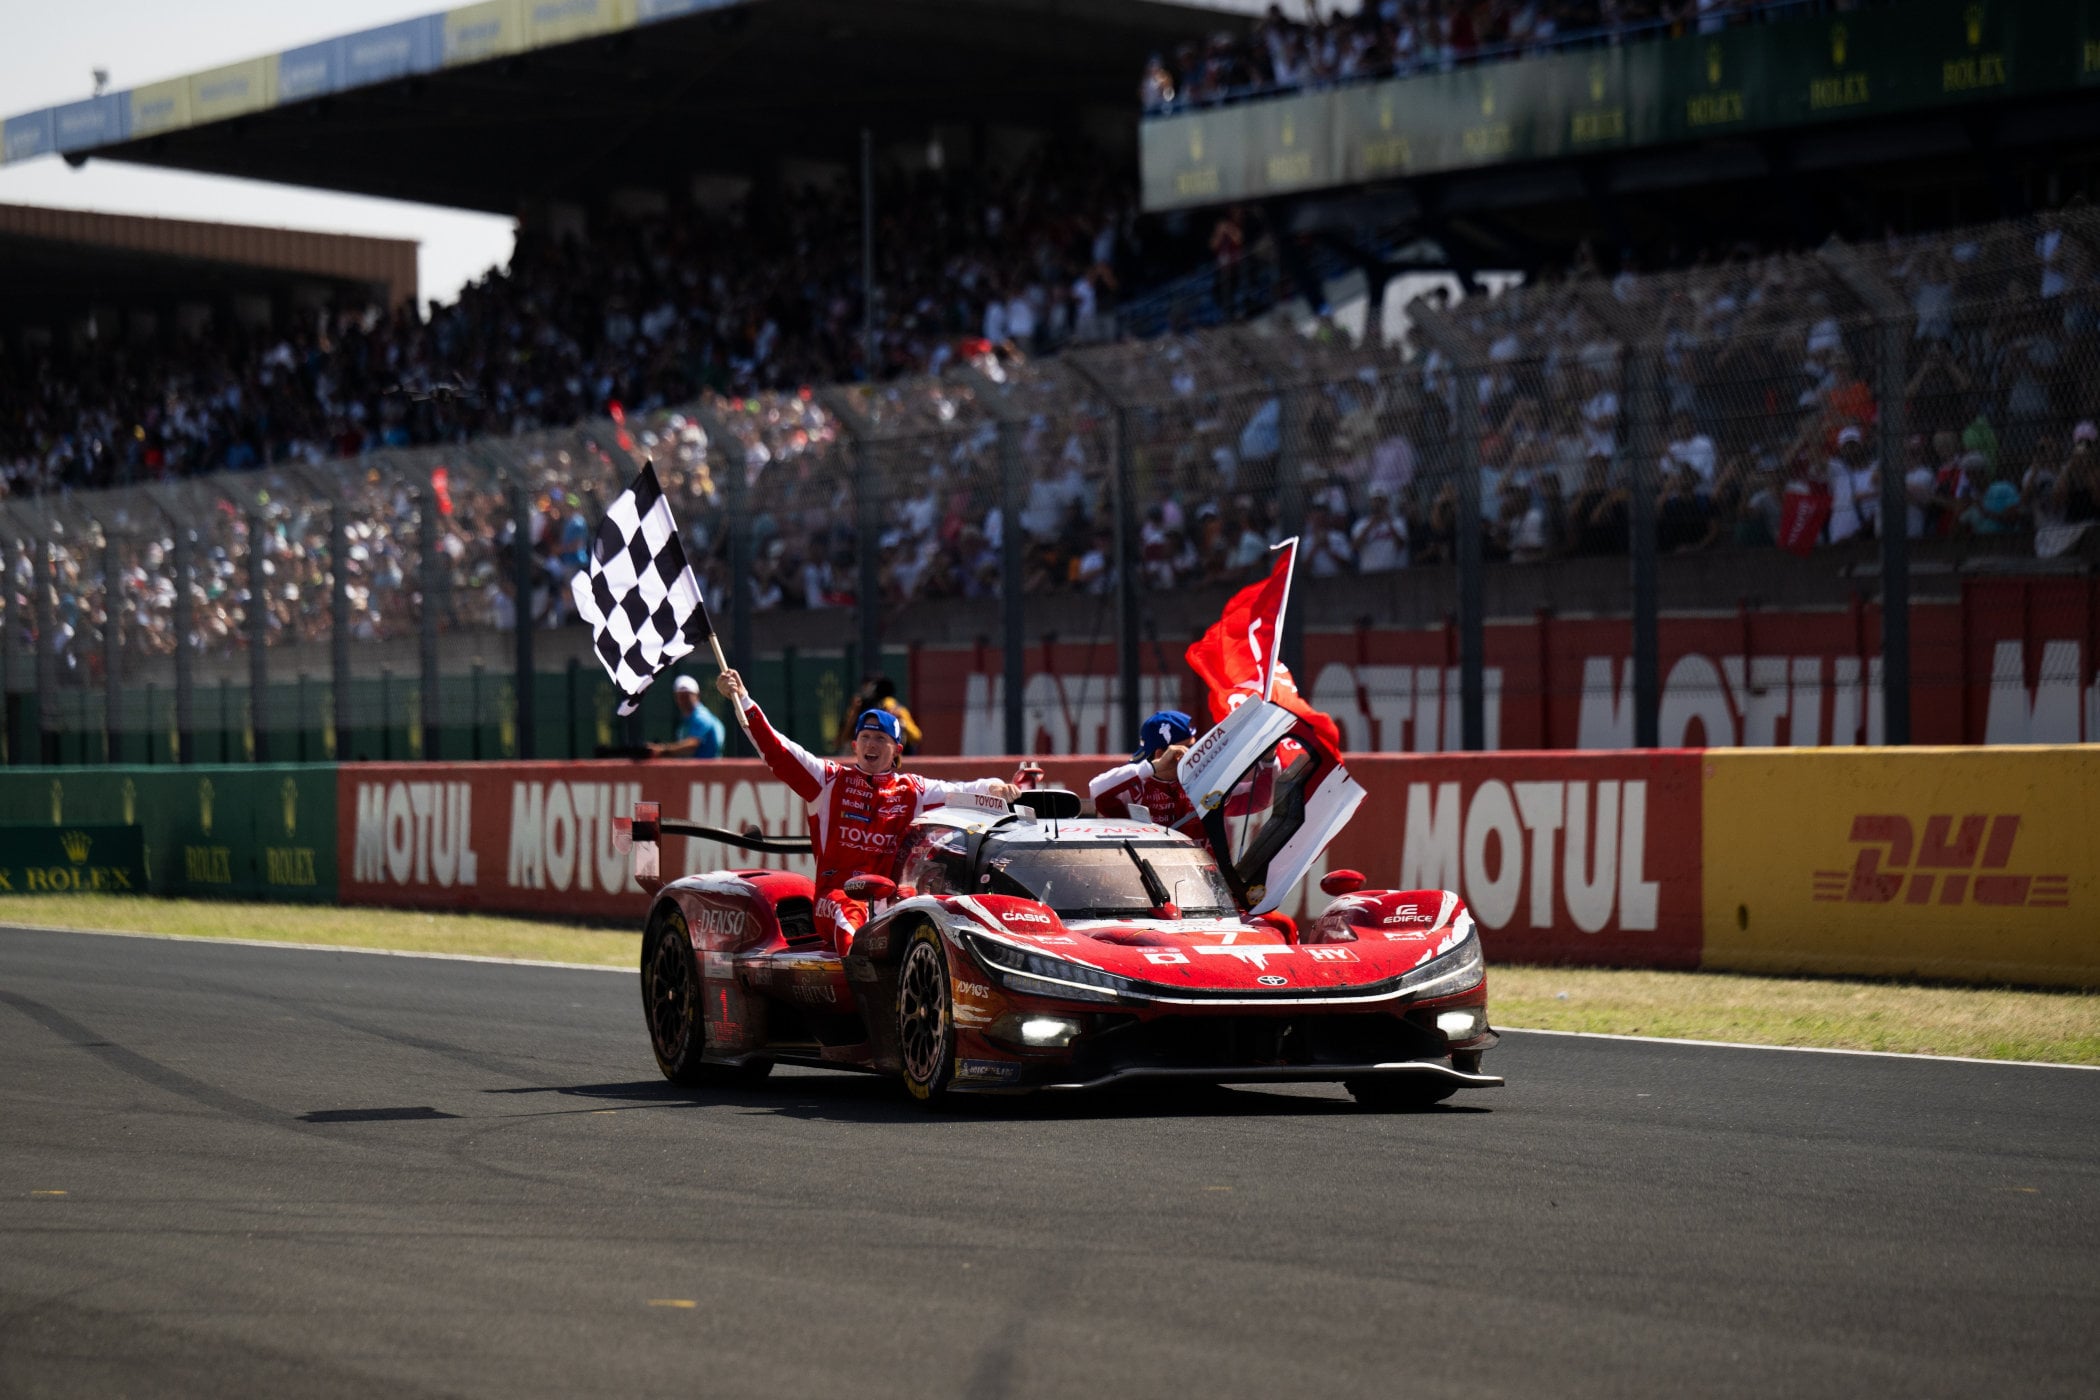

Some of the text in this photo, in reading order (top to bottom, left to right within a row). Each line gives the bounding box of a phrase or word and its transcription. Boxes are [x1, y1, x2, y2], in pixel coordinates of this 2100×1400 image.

[1185, 727, 1226, 770] TOYOTA
[841, 798, 865, 810] Mobil
[974, 794, 1003, 810] TOYOTA
[353, 780, 478, 888] MOTUL
[839, 826, 898, 847] TOYOTA
[1059, 827, 1159, 835] DENSO
[1400, 778, 1660, 933] MOTUL
[1843, 814, 2032, 905] DHL
[26, 866, 132, 891] ROLEX
[702, 909, 745, 935] DENSO
[1002, 912, 1051, 924] CASIO
[1383, 915, 1433, 924] EDIFICE
[1203, 931, 1238, 945] 7
[1311, 947, 1351, 960] HY
